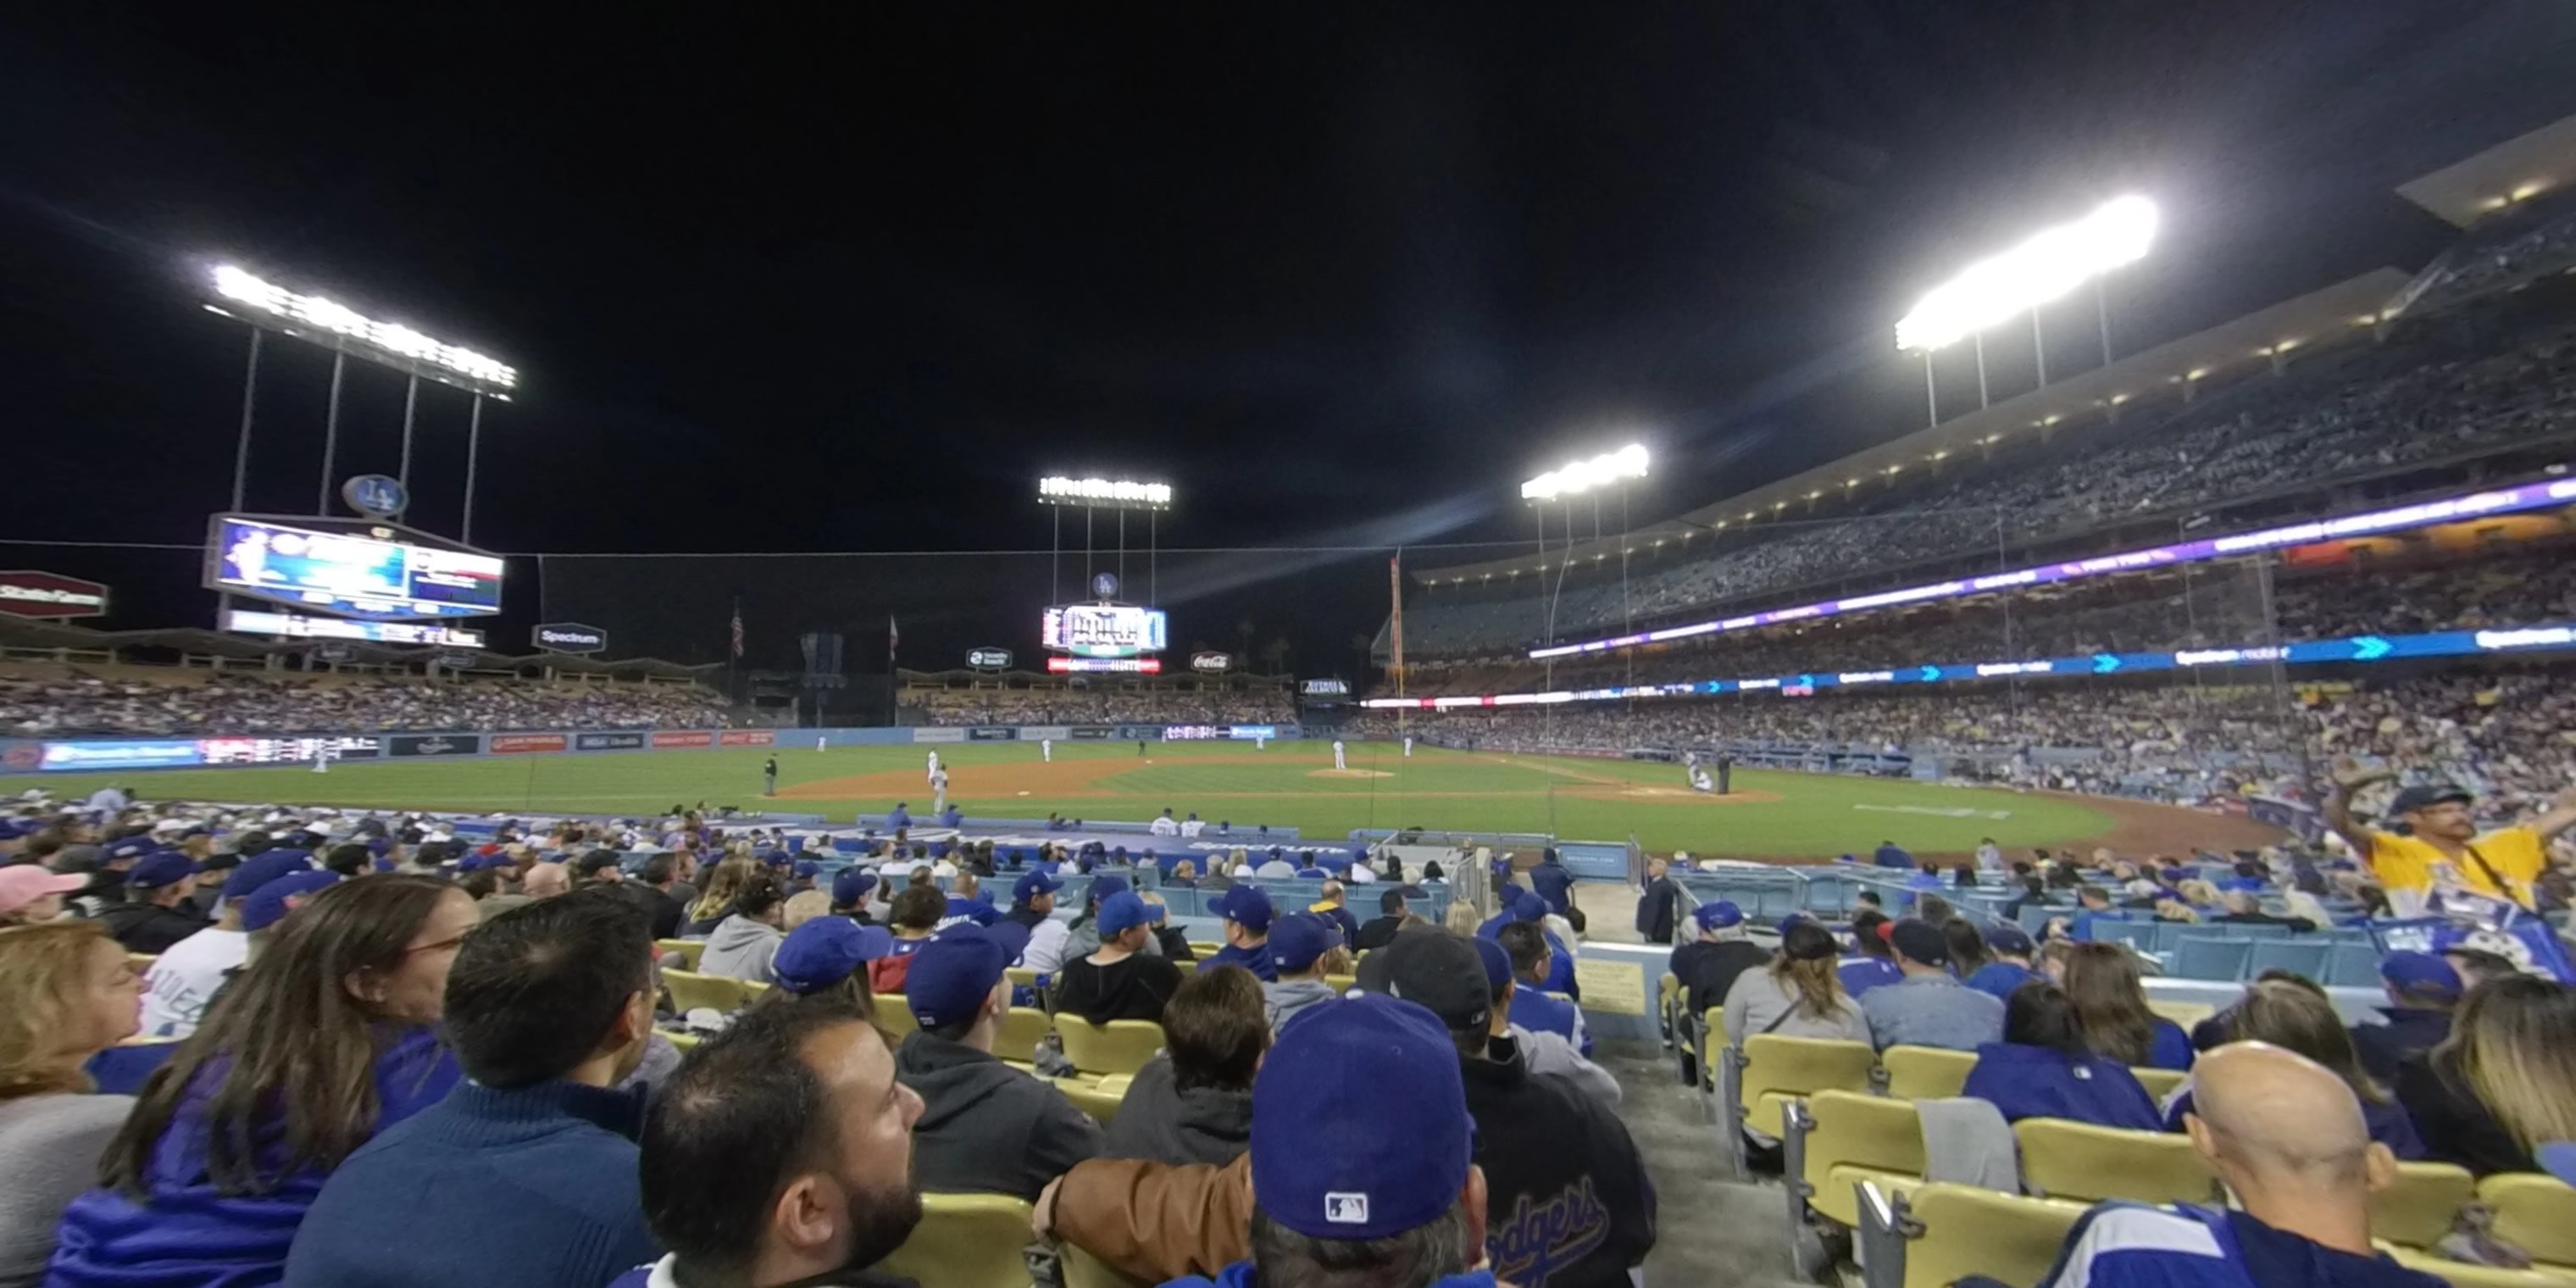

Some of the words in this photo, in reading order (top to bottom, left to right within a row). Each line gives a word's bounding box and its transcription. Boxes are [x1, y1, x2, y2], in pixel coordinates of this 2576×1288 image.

[366, 480, 395, 510] LA
[1098, 576, 1112, 593] LA
[541, 630, 601, 644] Spectrum
[1484, 1174, 1610, 1286] odgers
